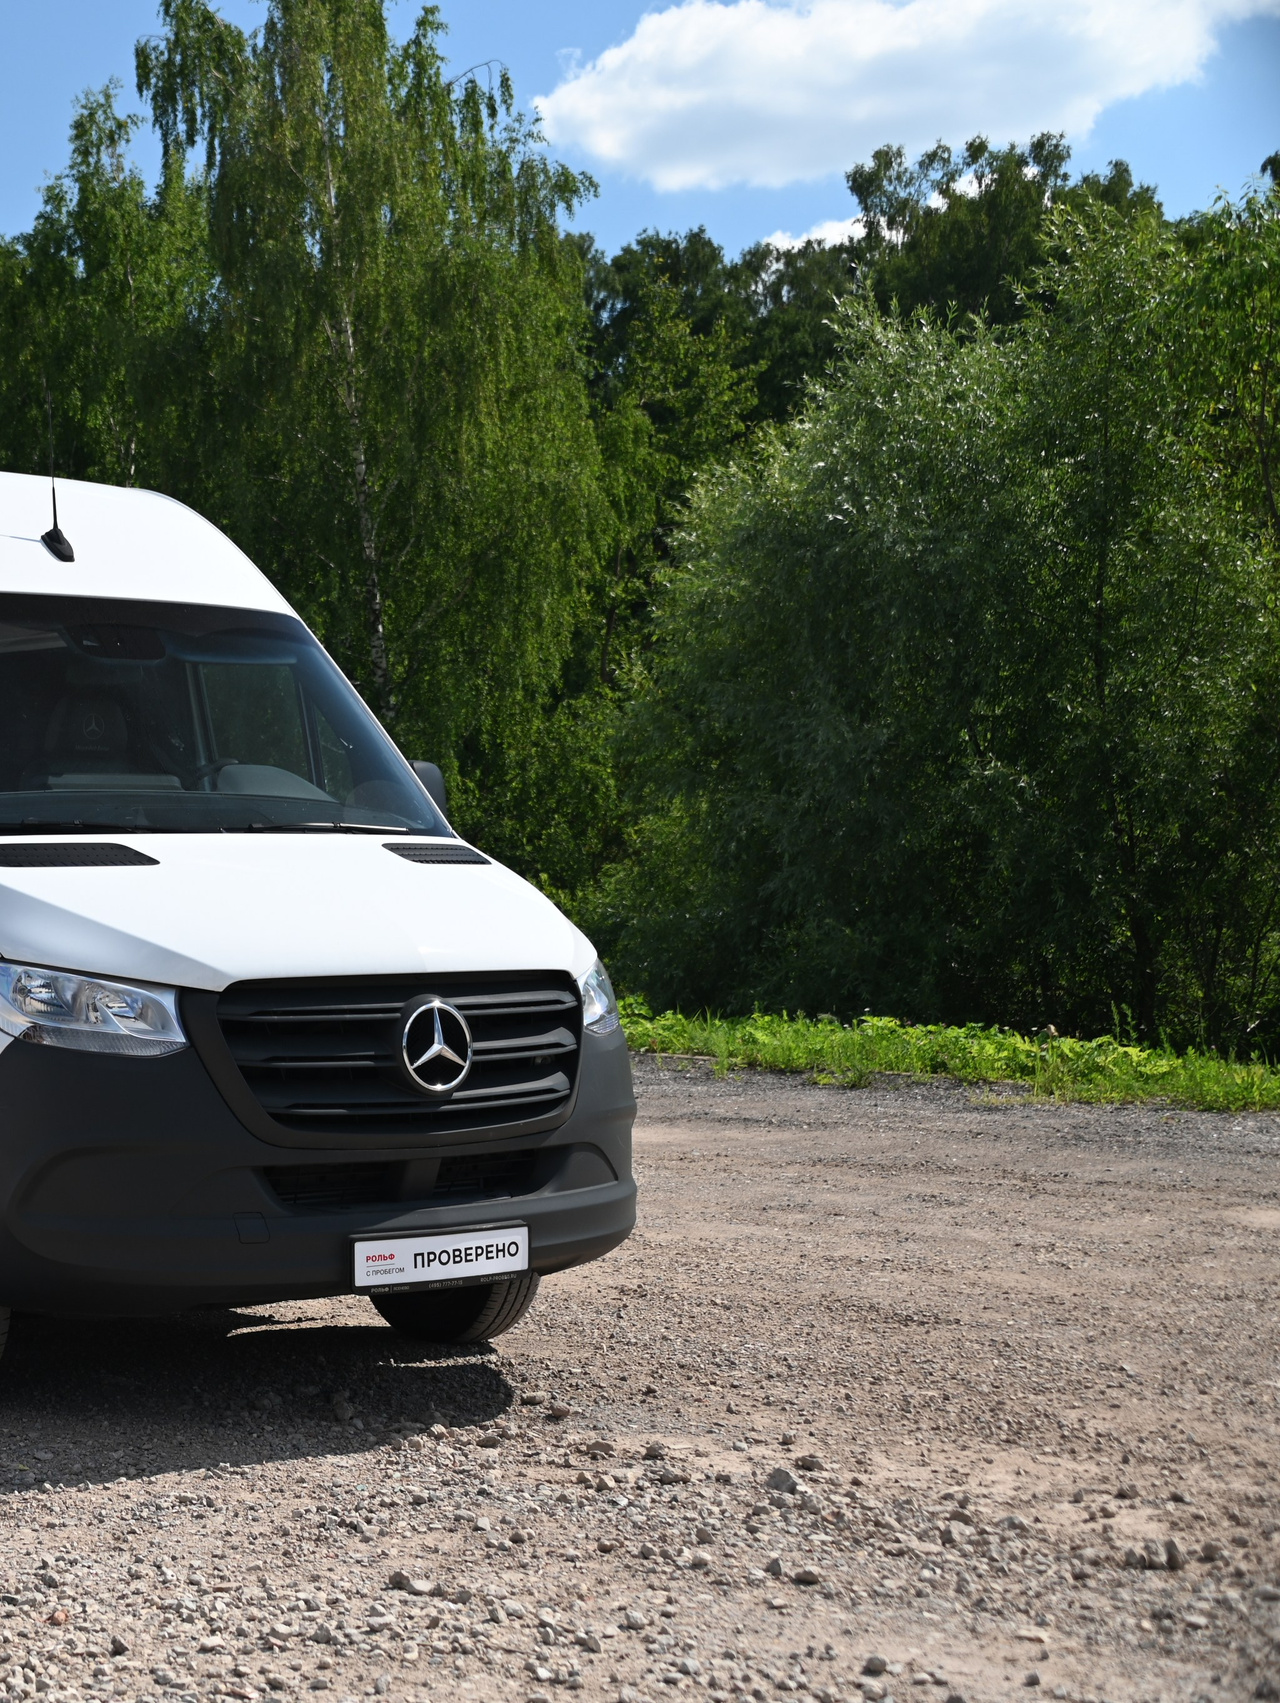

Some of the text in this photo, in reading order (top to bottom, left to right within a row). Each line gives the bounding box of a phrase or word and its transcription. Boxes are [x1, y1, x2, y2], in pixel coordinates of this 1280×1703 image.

[366, 1253, 395, 1263] РОЛЬФ
[413, 1241, 519, 1269] ПРОВЕРЕНО
[372, 1267, 405, 1276] ПРОБЕГОМ
